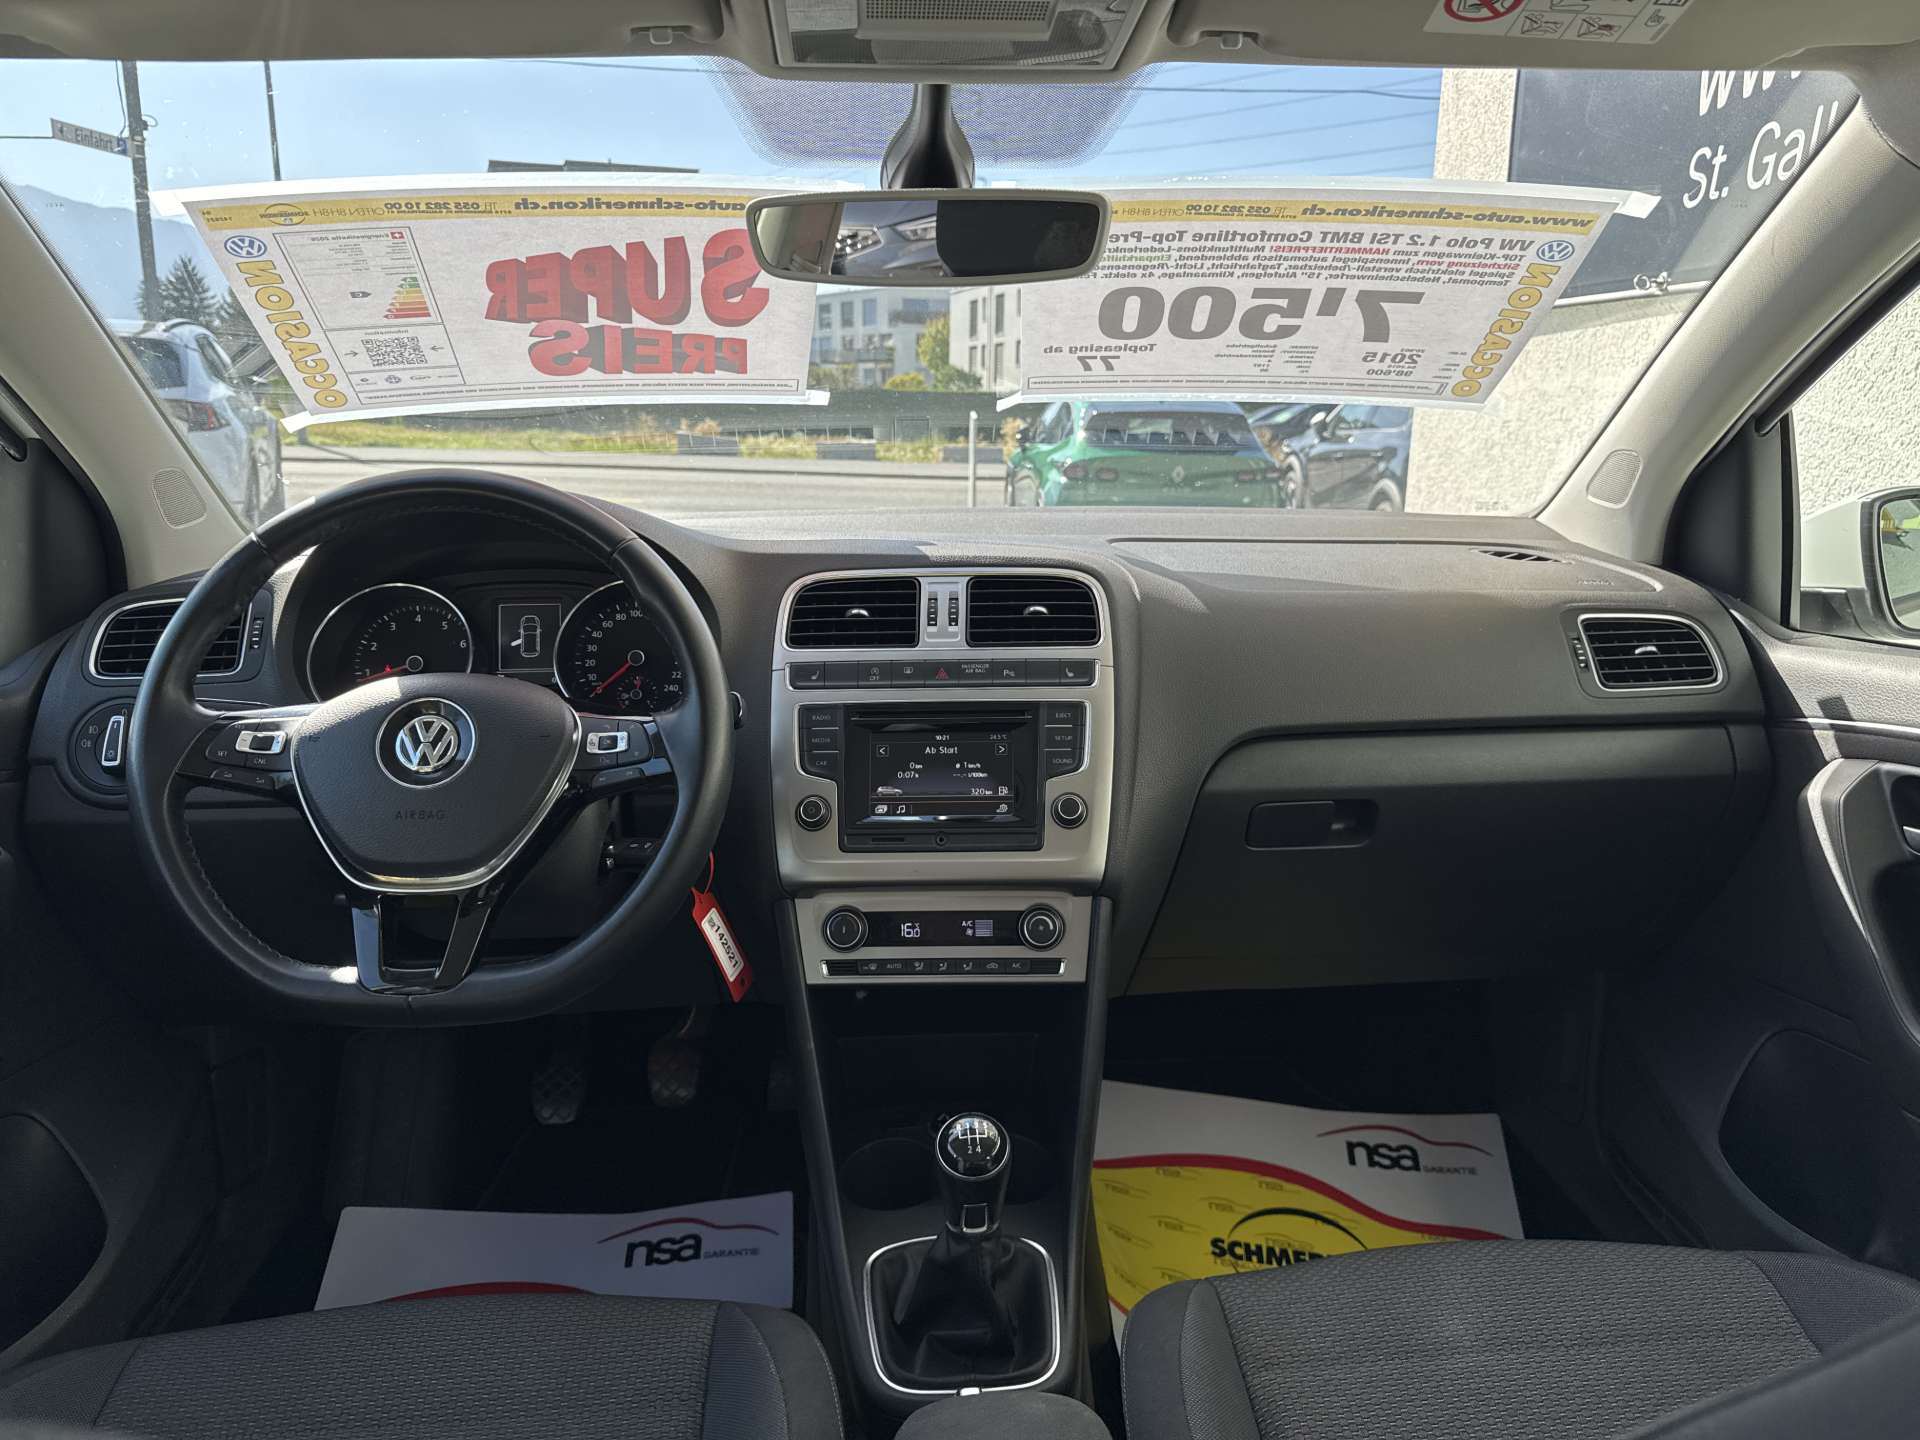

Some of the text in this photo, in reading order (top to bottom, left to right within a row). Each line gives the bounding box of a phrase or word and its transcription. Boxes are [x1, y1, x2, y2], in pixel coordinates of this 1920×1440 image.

[1699, 70, 1802, 117] ww
[75, 127, 114, 151] Einfahrt
[1683, 145, 1728, 209] St.
[414, 614, 421, 623] 4
[615, 613, 627, 621] 80
[390, 623, 396, 631] 3
[441, 622, 448, 631] 5
[602, 620, 614, 628] 60
[591, 630, 603, 638] 40
[370, 642, 378, 651] 2
[460, 640, 467, 649] 6
[587, 644, 598, 652] 30
[585, 659, 596, 667] 20
[587, 673, 597, 681] 10
[664, 684, 679, 692] 240
[924, 746, 958, 754] Ab Start
[396, 809, 446, 821] AIRBAG
[1345, 1140, 1421, 1172] nsa
[624, 1233, 702, 1269] nsa
[1211, 1237, 1324, 1267] SCHME
